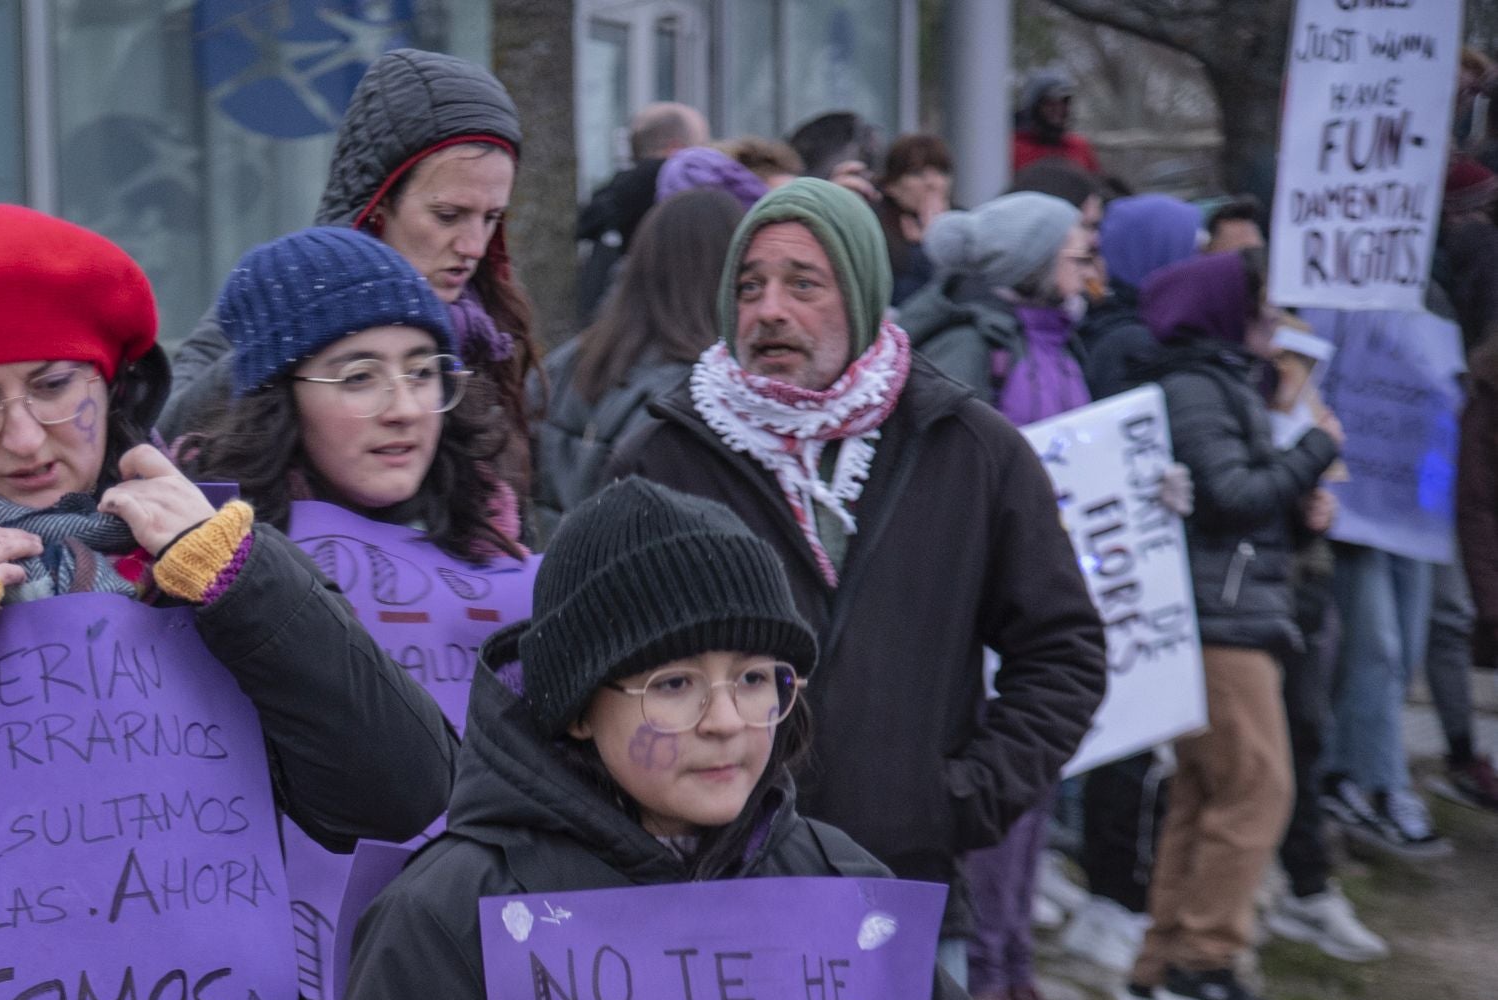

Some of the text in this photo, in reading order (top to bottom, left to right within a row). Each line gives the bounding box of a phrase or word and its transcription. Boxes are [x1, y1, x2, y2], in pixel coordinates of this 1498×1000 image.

[1296, 22, 1359, 63] JUST
[1330, 76, 1402, 110] HAVE
[1317, 113, 1425, 174] FUN-
[108, 847, 276, 924] AHORA
